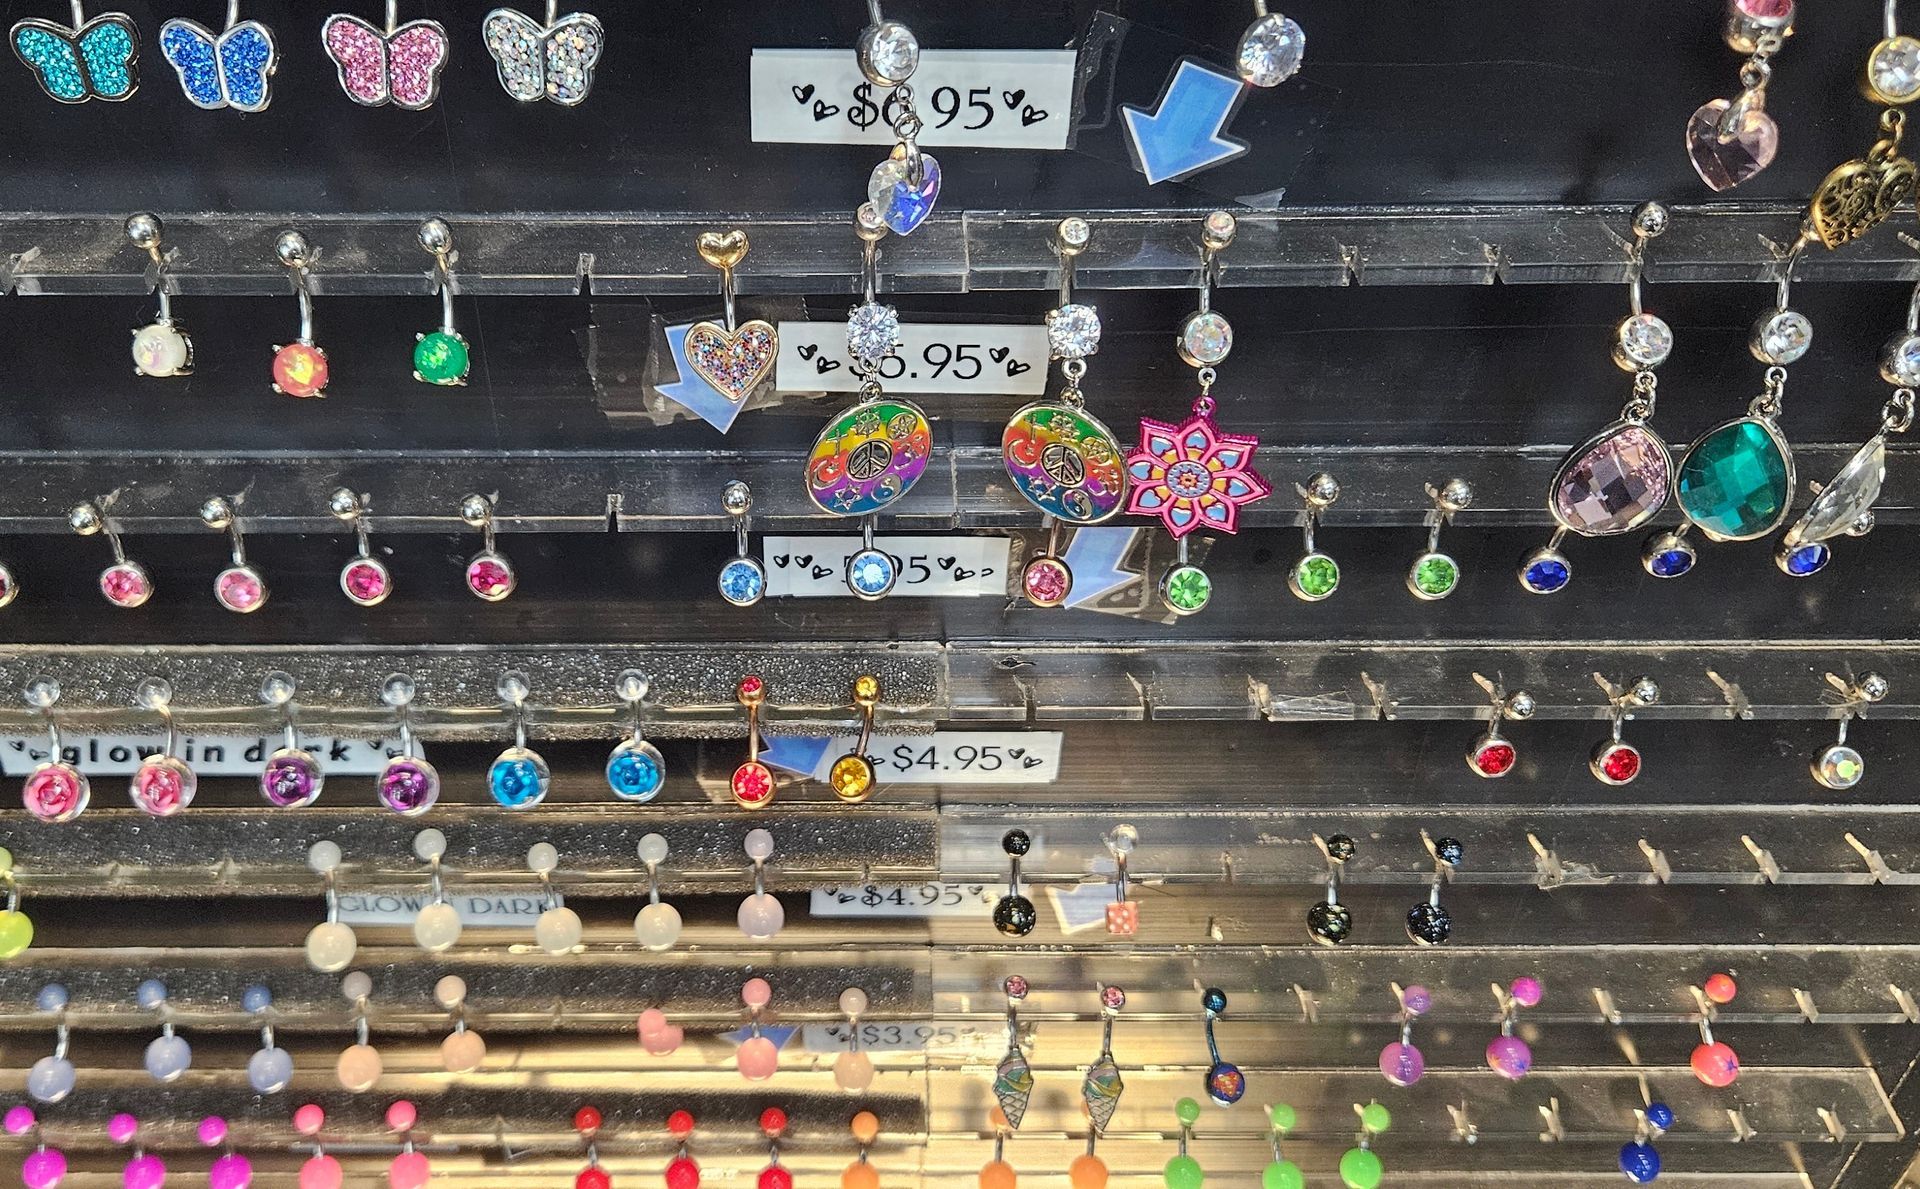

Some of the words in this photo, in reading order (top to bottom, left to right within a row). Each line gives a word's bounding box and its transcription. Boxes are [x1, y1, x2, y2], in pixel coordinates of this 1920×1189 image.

[186, 738, 225, 762] in
[892, 744, 1003, 772] $4.95
[861, 884, 963, 907] $4.95
[862, 1024, 957, 1045] $3.95
